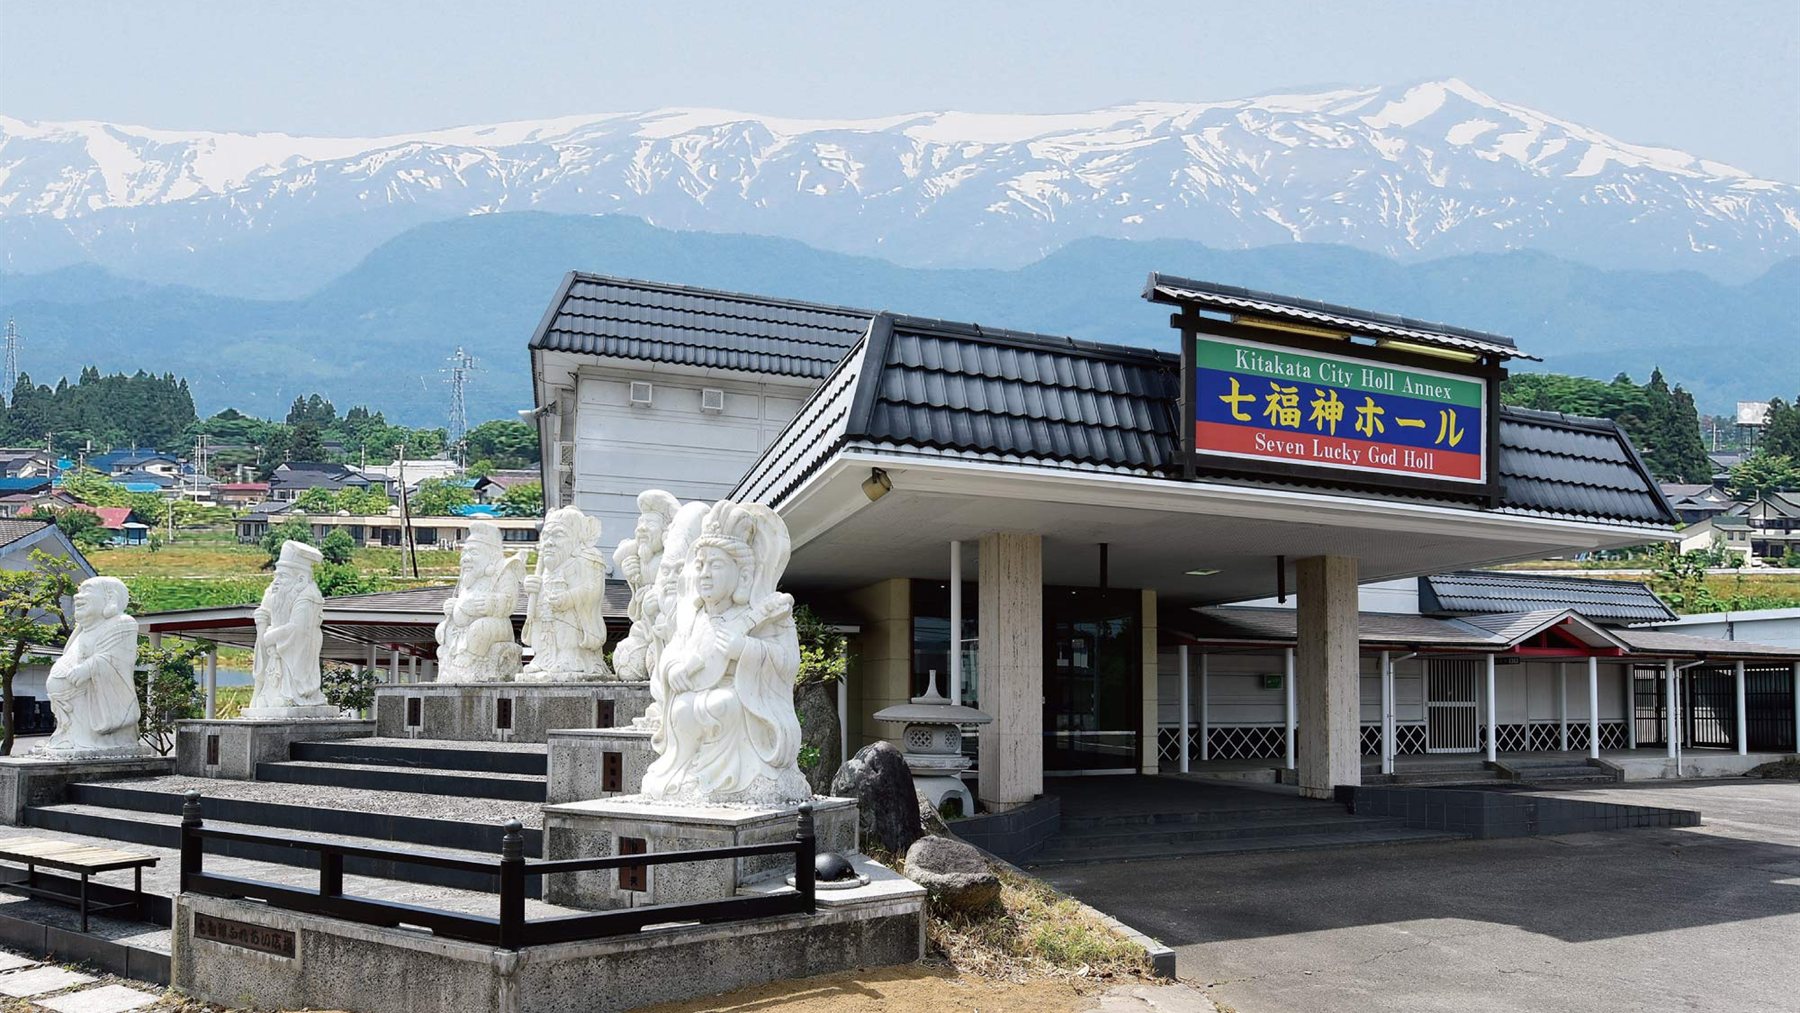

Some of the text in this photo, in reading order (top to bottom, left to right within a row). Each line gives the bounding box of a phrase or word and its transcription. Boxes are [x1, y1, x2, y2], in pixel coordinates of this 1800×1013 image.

[1235, 348, 1452, 399] Kitakata City Holl Annex
[1218, 376, 1465, 448] 七福神ホール
[1255, 432, 1434, 470] Seven Lucky God Holl
